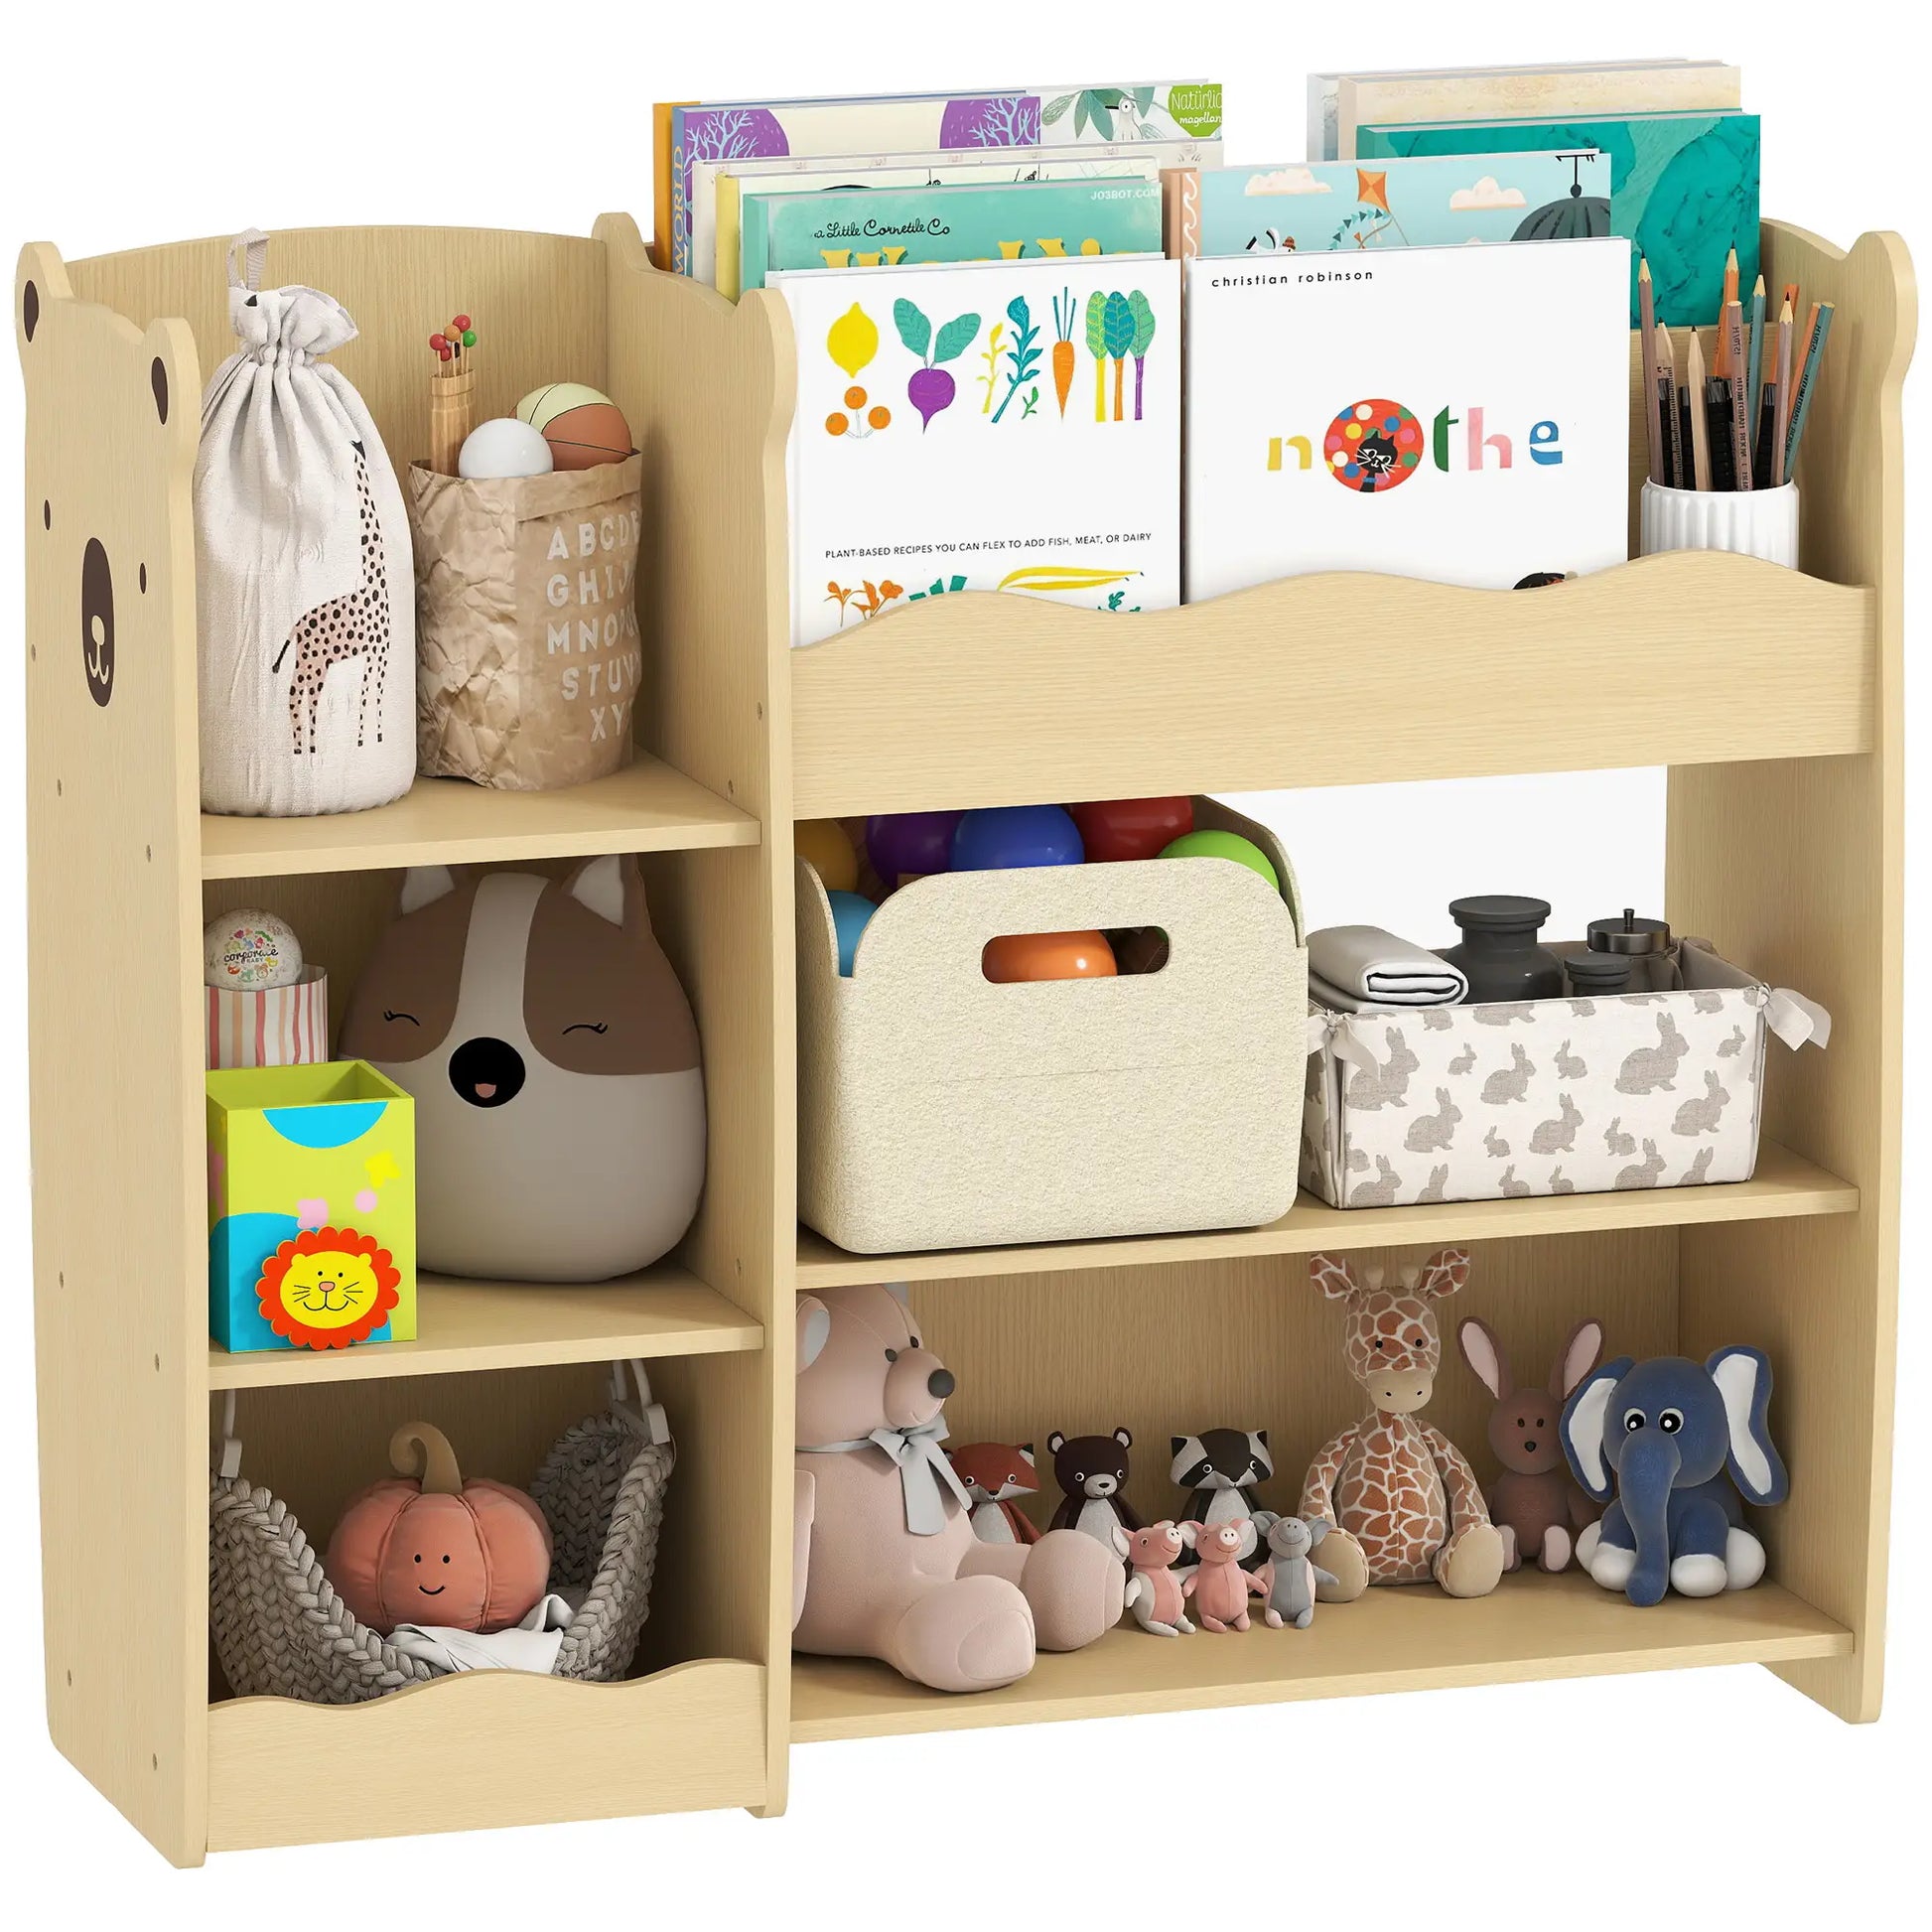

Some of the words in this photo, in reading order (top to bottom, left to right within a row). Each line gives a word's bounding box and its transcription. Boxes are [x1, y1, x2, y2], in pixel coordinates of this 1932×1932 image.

[826, 221, 861, 238] Little
[926, 217, 950, 236] Co
[1211, 275, 1288, 287] christian
[1298, 271, 1373, 283] robinson
[825, 547, 891, 559] PLANT-BASED
[894, 544, 932, 555] RECIPES
[935, 543, 956, 553] YOU
[959, 542, 980, 551] CAN
[983, 540, 1006, 550] FLEX
[1008, 539, 1022, 549] TO
[1025, 538, 1045, 548] ADD
[1048, 536, 1072, 547] FISH,
[1075, 535, 1104, 545] MEAT,
[1106, 534, 1120, 544] OR
[1123, 532, 1153, 542] DAIRY
